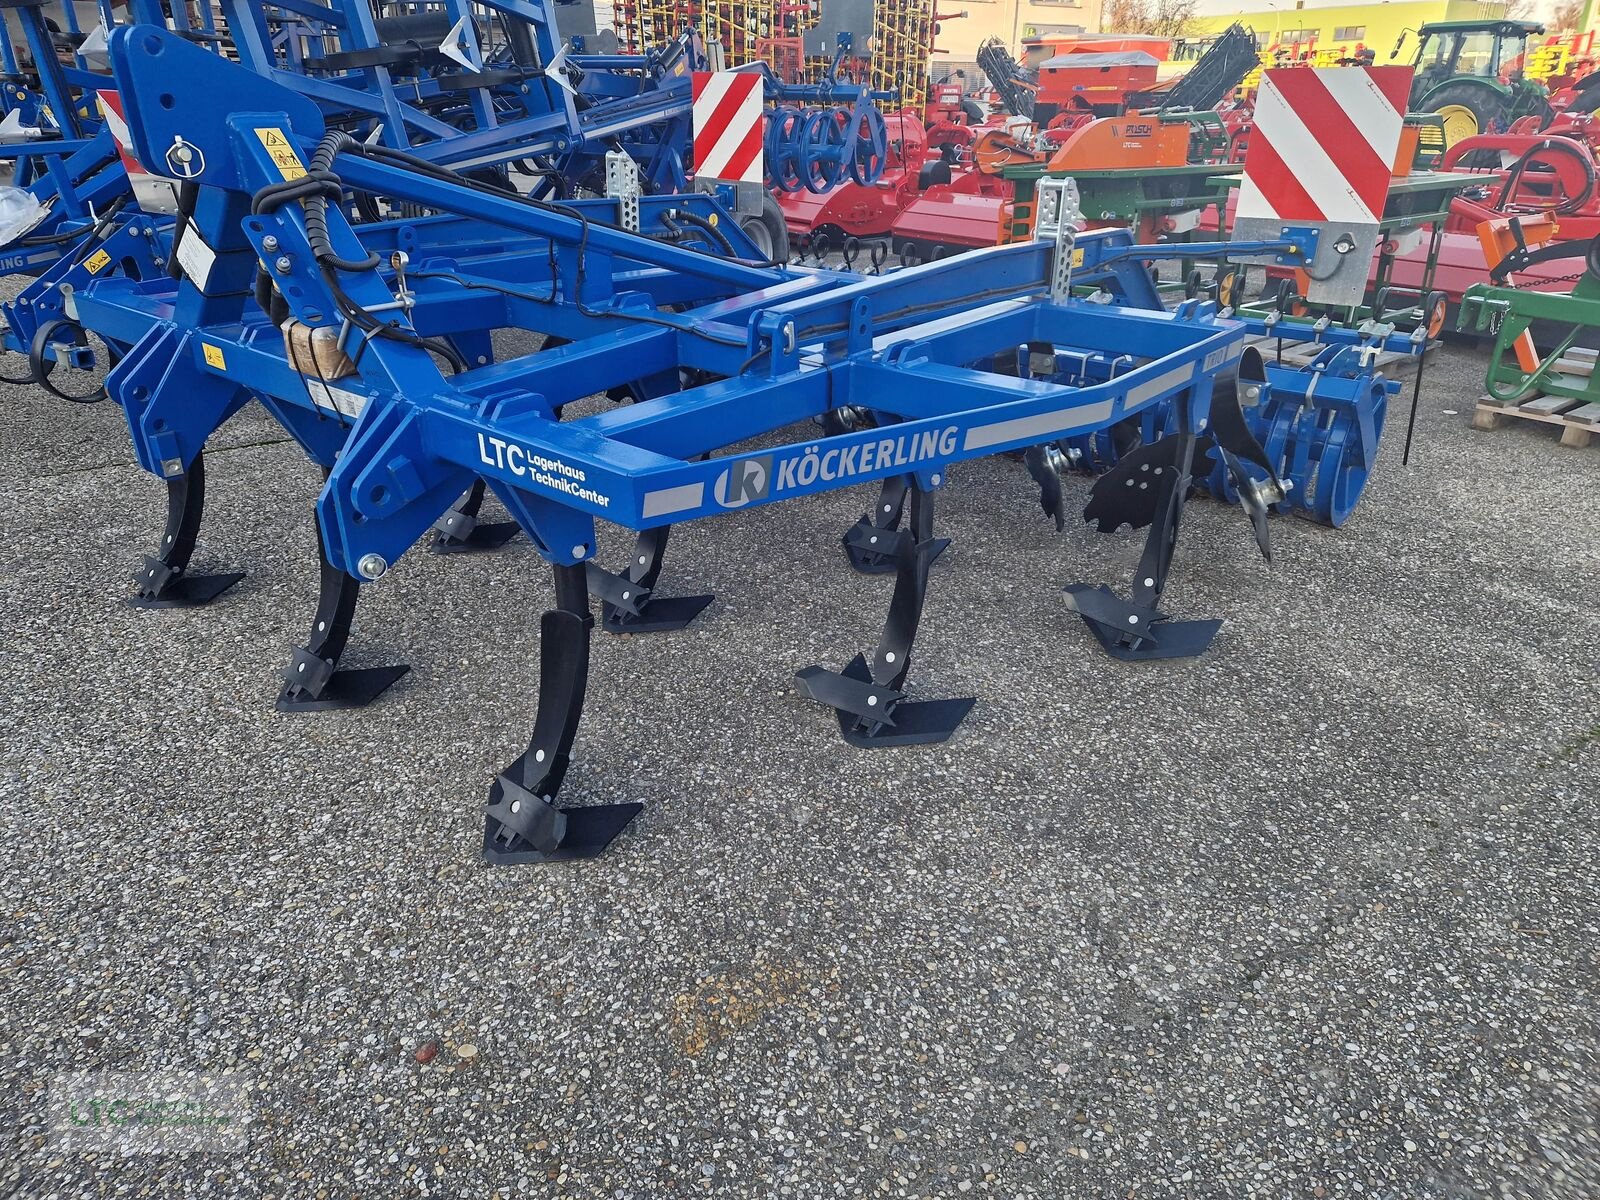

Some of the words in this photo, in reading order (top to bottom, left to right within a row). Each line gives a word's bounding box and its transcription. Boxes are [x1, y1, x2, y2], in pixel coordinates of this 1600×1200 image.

[0, 255, 24, 271] ING
[477, 432, 526, 476] LTC
[526, 449, 586, 482] Lagerhaus
[776, 425, 959, 492] KÖCKERLING
[528, 466, 610, 508] TechnikCenter
